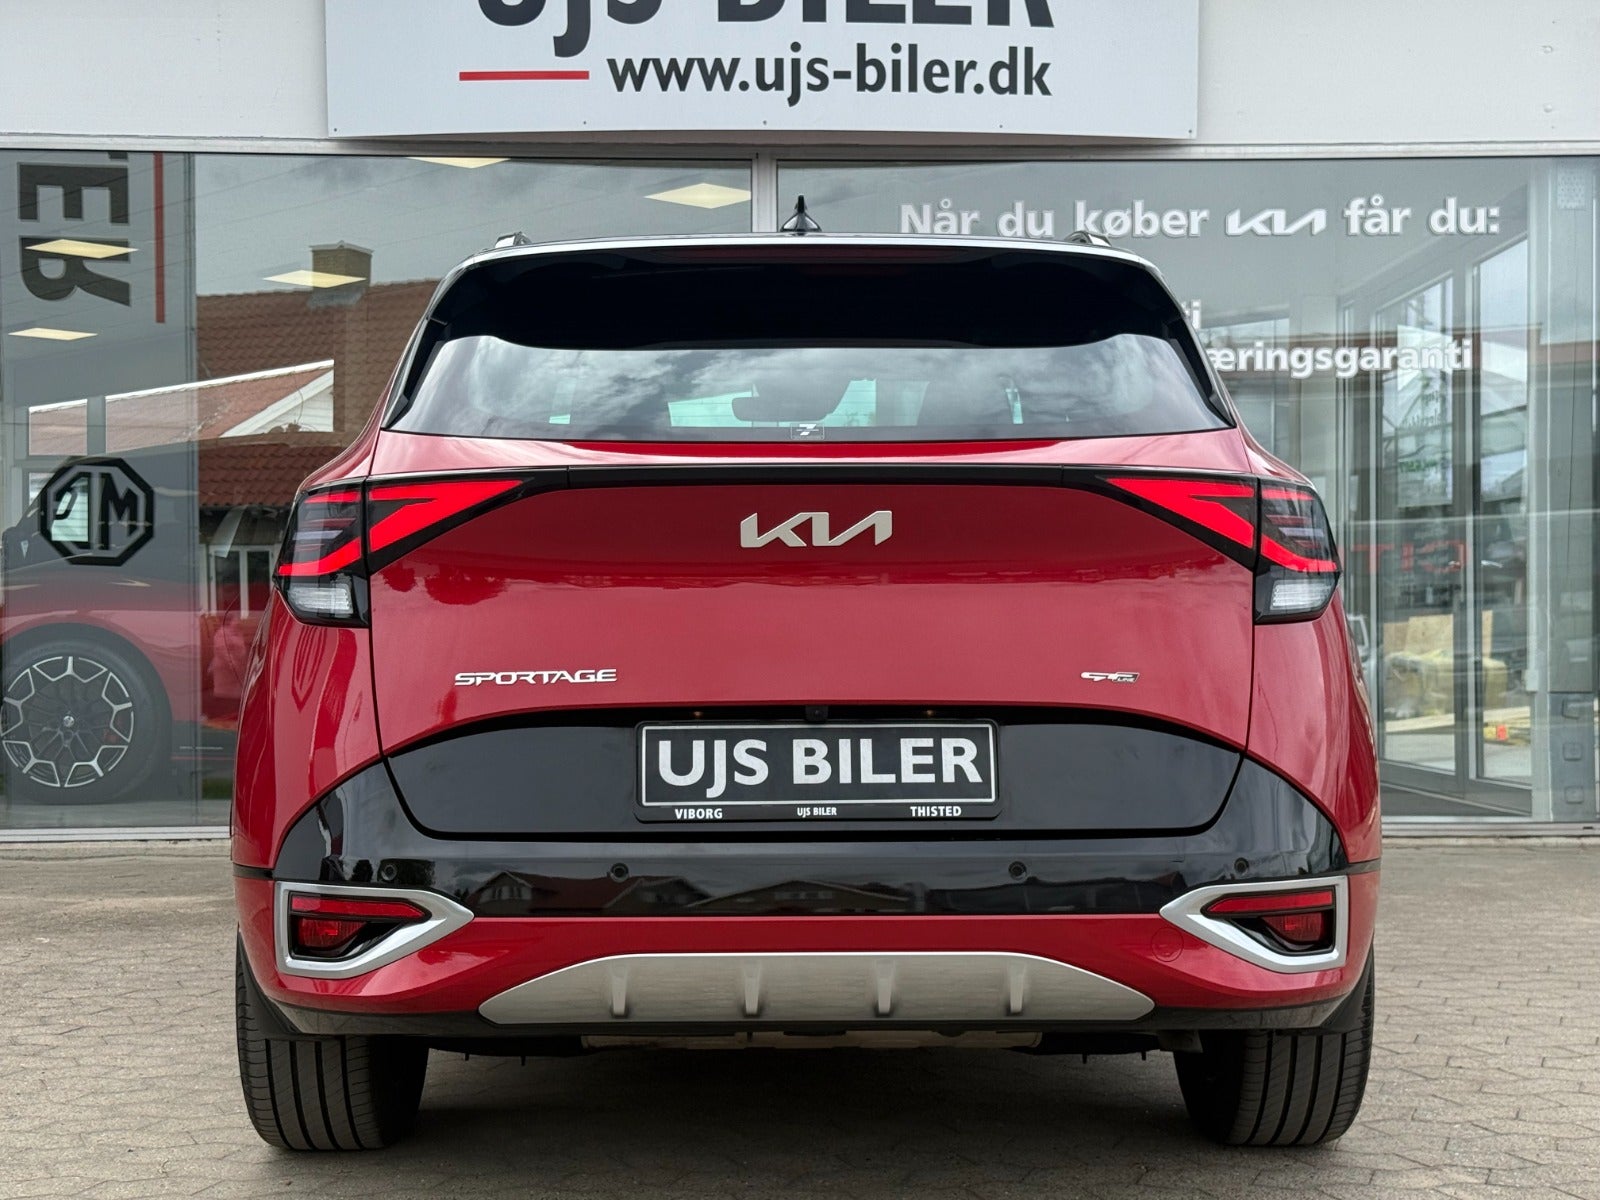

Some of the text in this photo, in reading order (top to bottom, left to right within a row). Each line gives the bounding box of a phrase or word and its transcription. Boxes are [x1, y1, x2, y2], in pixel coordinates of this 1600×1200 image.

[606, 41, 1053, 107] www.ujs-biler.dk
[900, 198, 979, 235] Når
[998, 200, 1055, 238] du
[1075, 199, 1209, 239] køber
[1344, 193, 1411, 236] får
[1428, 197, 1500, 235] du:
[740, 510, 893, 548] KIA
[454, 668, 618, 687] SPORTAGE
[657, 737, 983, 799] UJS BILER
[674, 808, 724, 820] VIBORG
[796, 806, 837, 818] UJS BILER
[910, 805, 962, 817] THISTED
